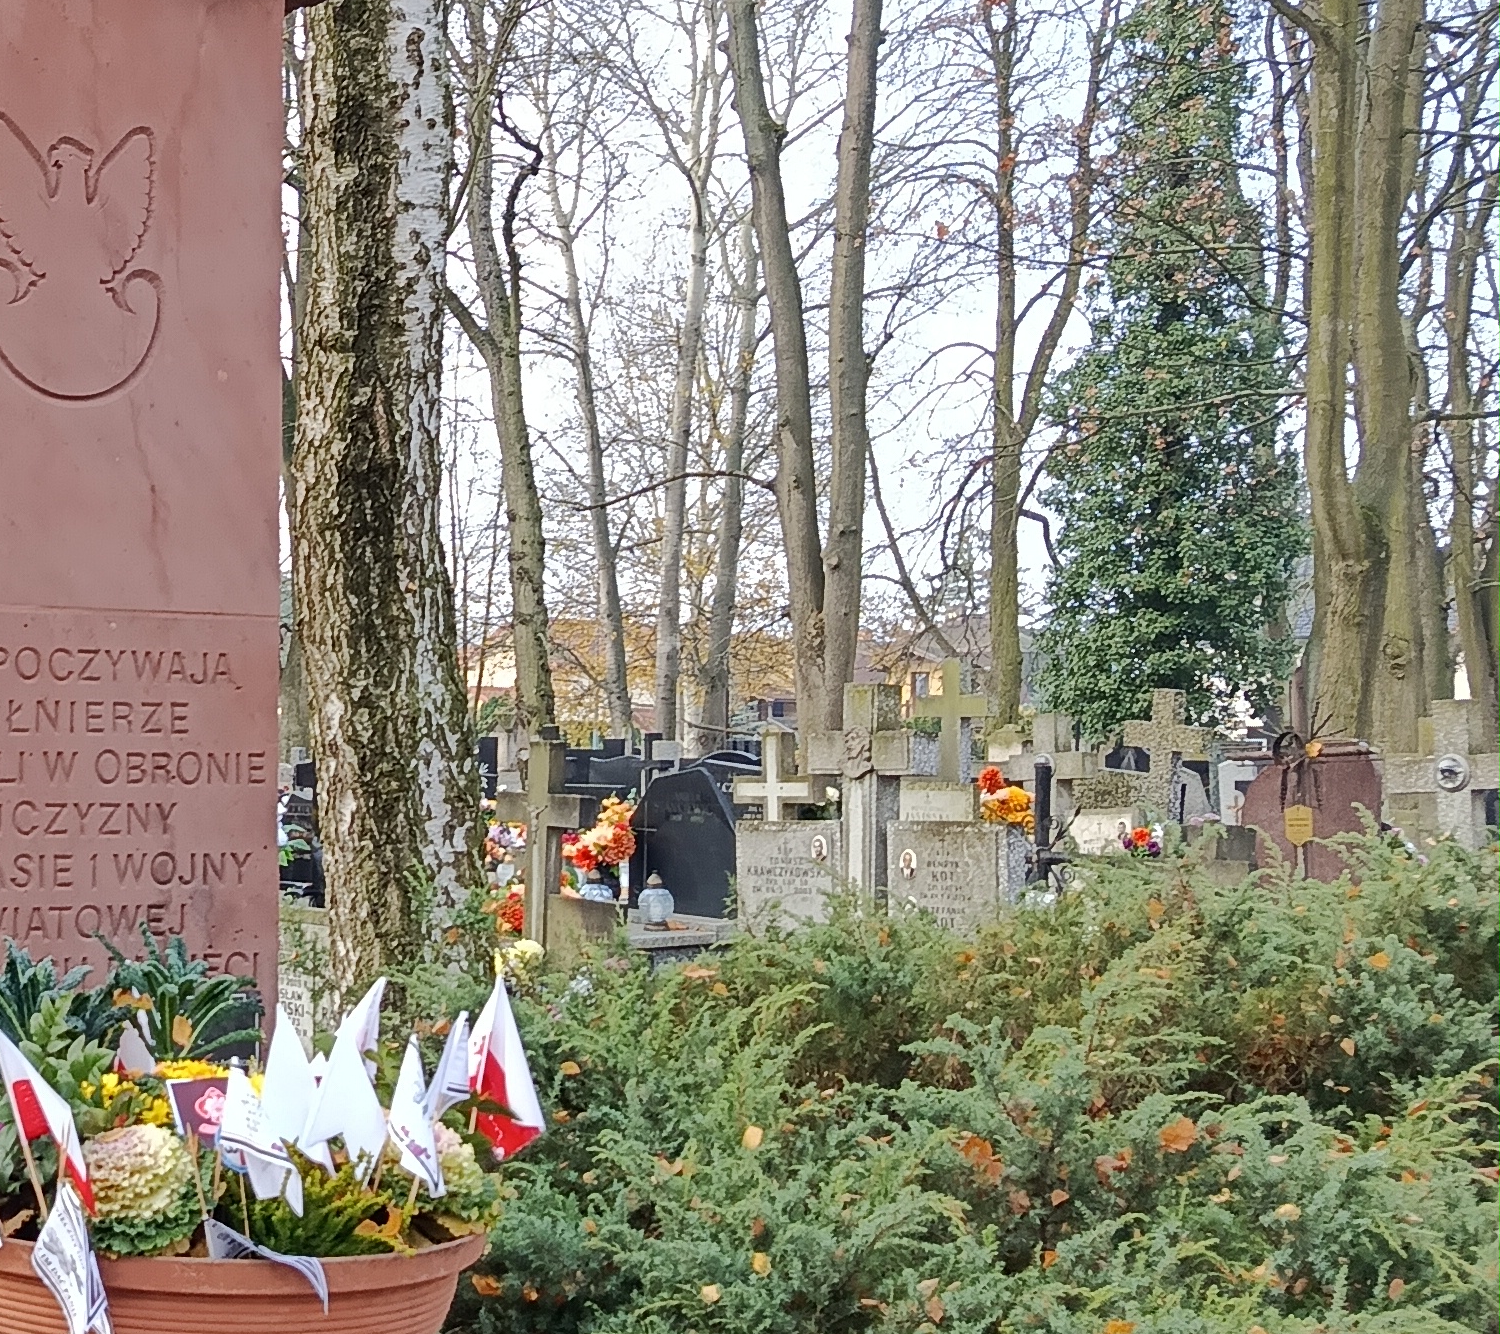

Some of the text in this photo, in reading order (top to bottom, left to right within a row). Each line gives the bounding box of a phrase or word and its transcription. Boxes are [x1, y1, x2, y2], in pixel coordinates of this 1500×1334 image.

[42, 750, 79, 783] W
[95, 748, 266, 785] OBRONIE
[112, 851, 253, 886] WOJNY
